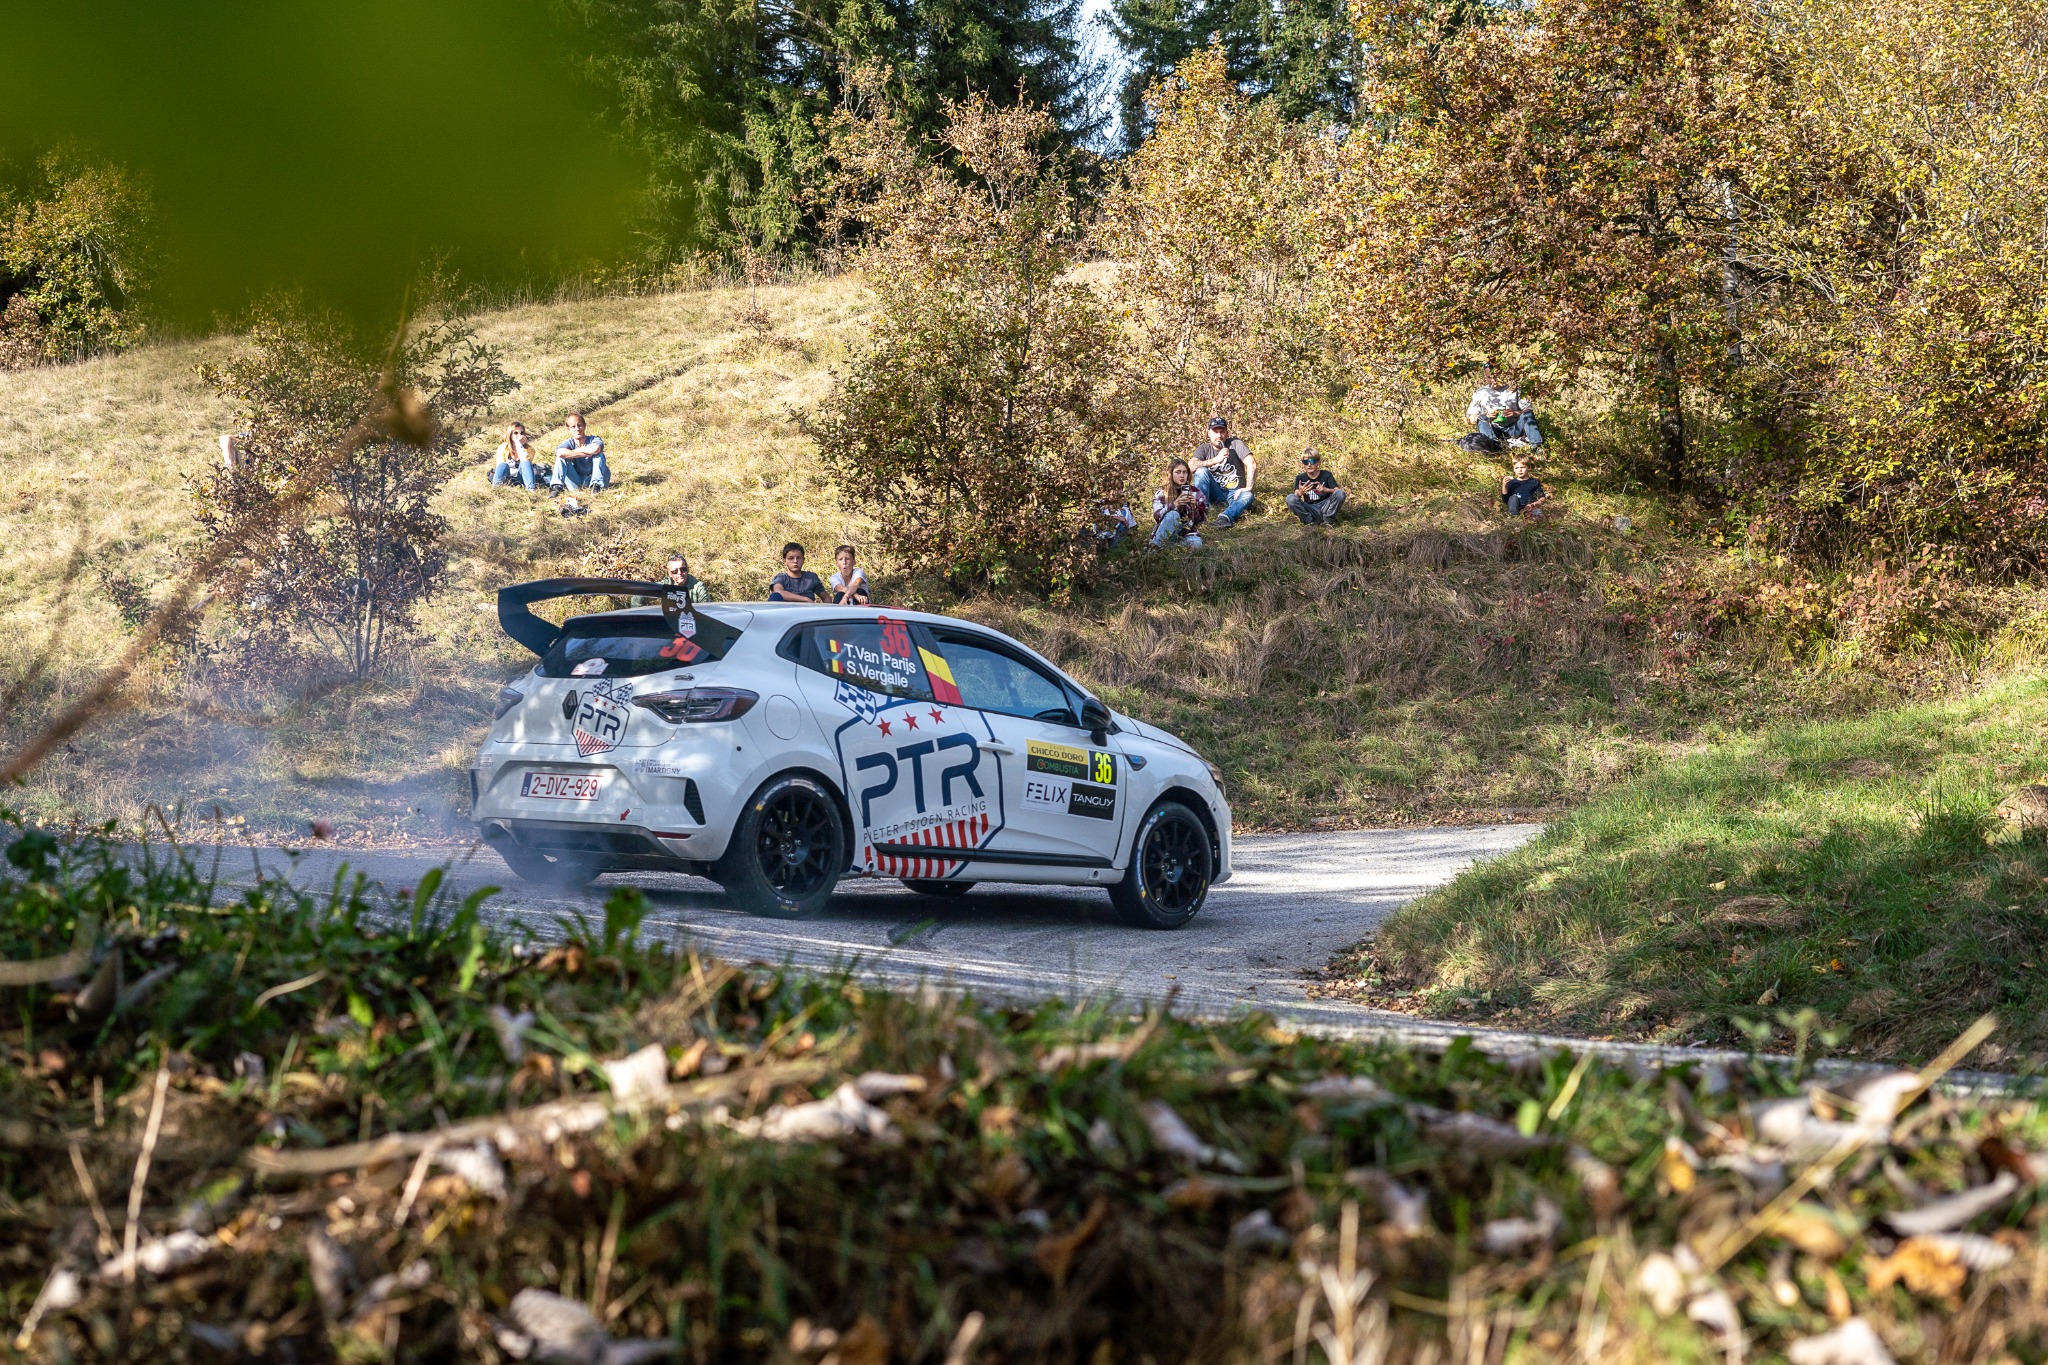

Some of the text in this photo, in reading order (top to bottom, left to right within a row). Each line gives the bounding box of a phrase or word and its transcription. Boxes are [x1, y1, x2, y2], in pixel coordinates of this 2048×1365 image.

[680, 622, 694, 630] PTR
[877, 615, 911, 658] 36
[843, 643, 917, 676] T.Van Parijs
[846, 661, 909, 688] S.Vergalle
[579, 703, 621, 741] PTR
[1031, 746, 1060, 758] CHICCO
[648, 766, 681, 775] MARTIGNY
[1036, 758, 1080, 775] COMBUSTIA
[1094, 752, 1113, 784] 36
[531, 776, 599, 798] 2-DVZ-929
[855, 732, 985, 829] PTR
[1026, 782, 1068, 804] FELIX
[1072, 793, 1114, 808] TANGUY
[863, 800, 988, 844] PIETER TSJOEN RACING
